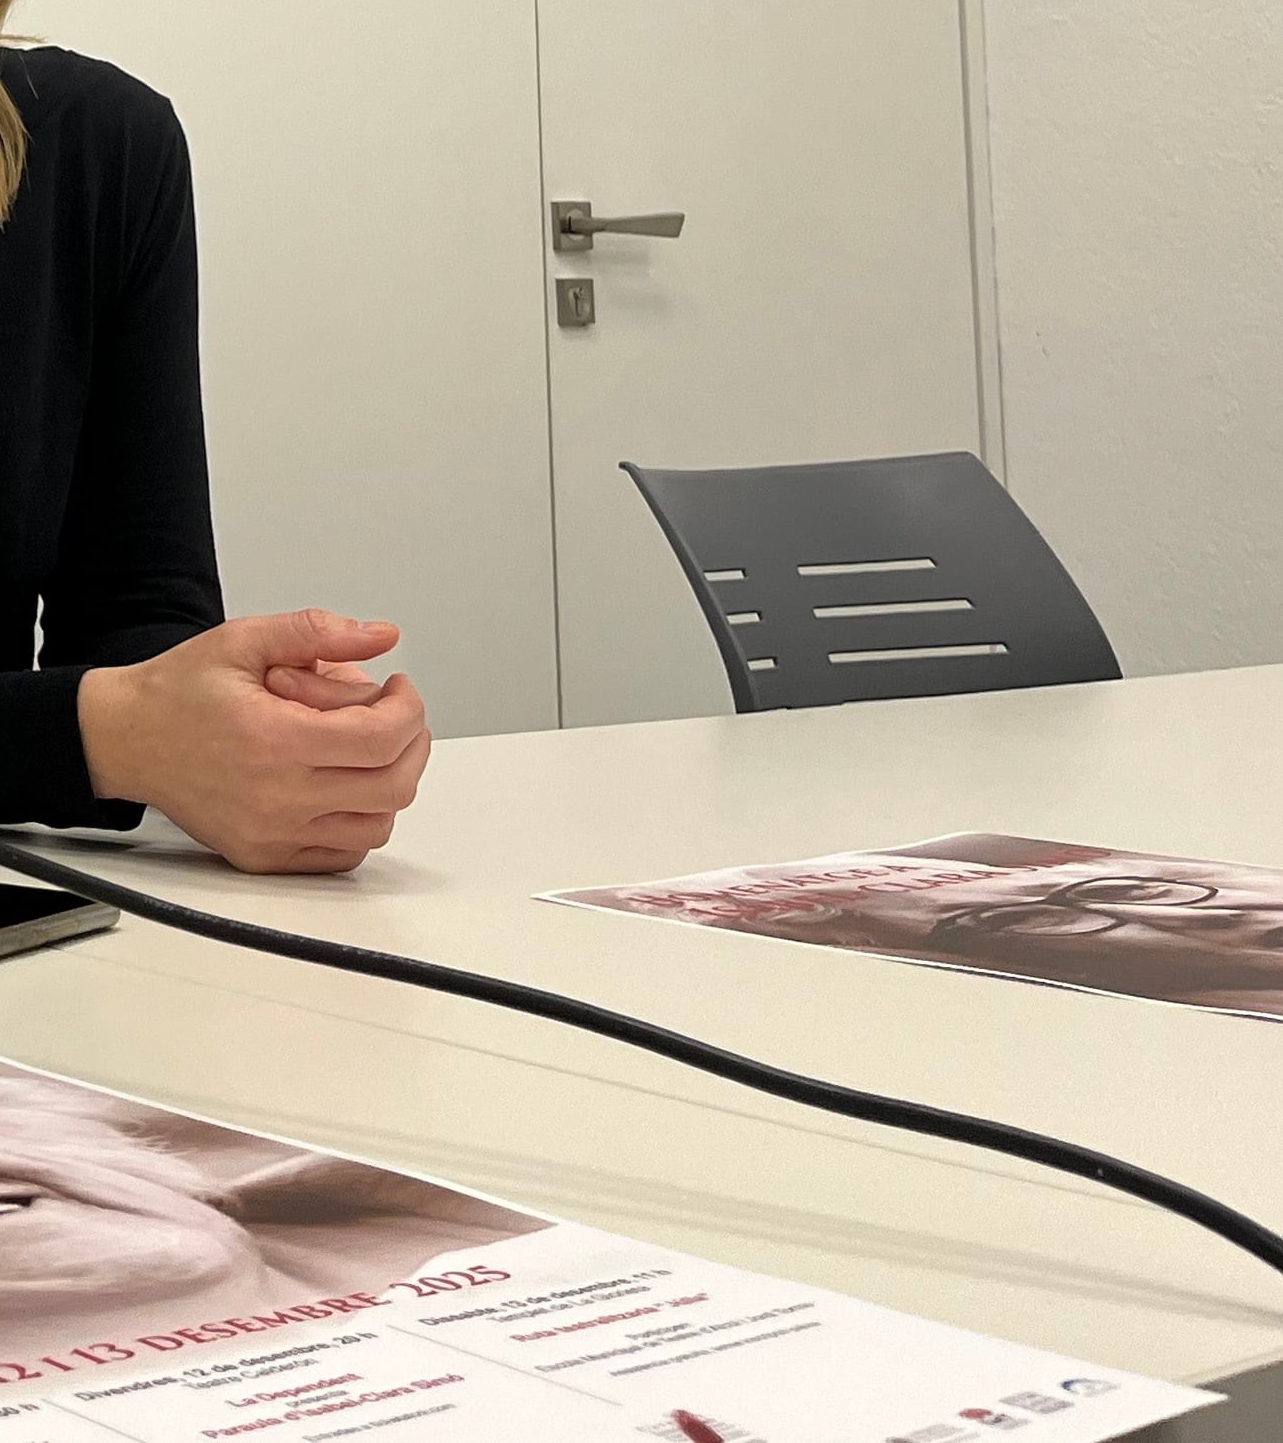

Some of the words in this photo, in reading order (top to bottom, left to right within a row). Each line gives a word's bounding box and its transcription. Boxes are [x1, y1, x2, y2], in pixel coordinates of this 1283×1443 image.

[70, 1342, 136, 1365] 13
[136, 1290, 393, 1352] DESEMBRE
[388, 1264, 512, 1300] 2025
[74, 1374, 186, 1402] Divendres,
[183, 1366, 211, 1379] 12
[210, 1362, 238, 1374] de
